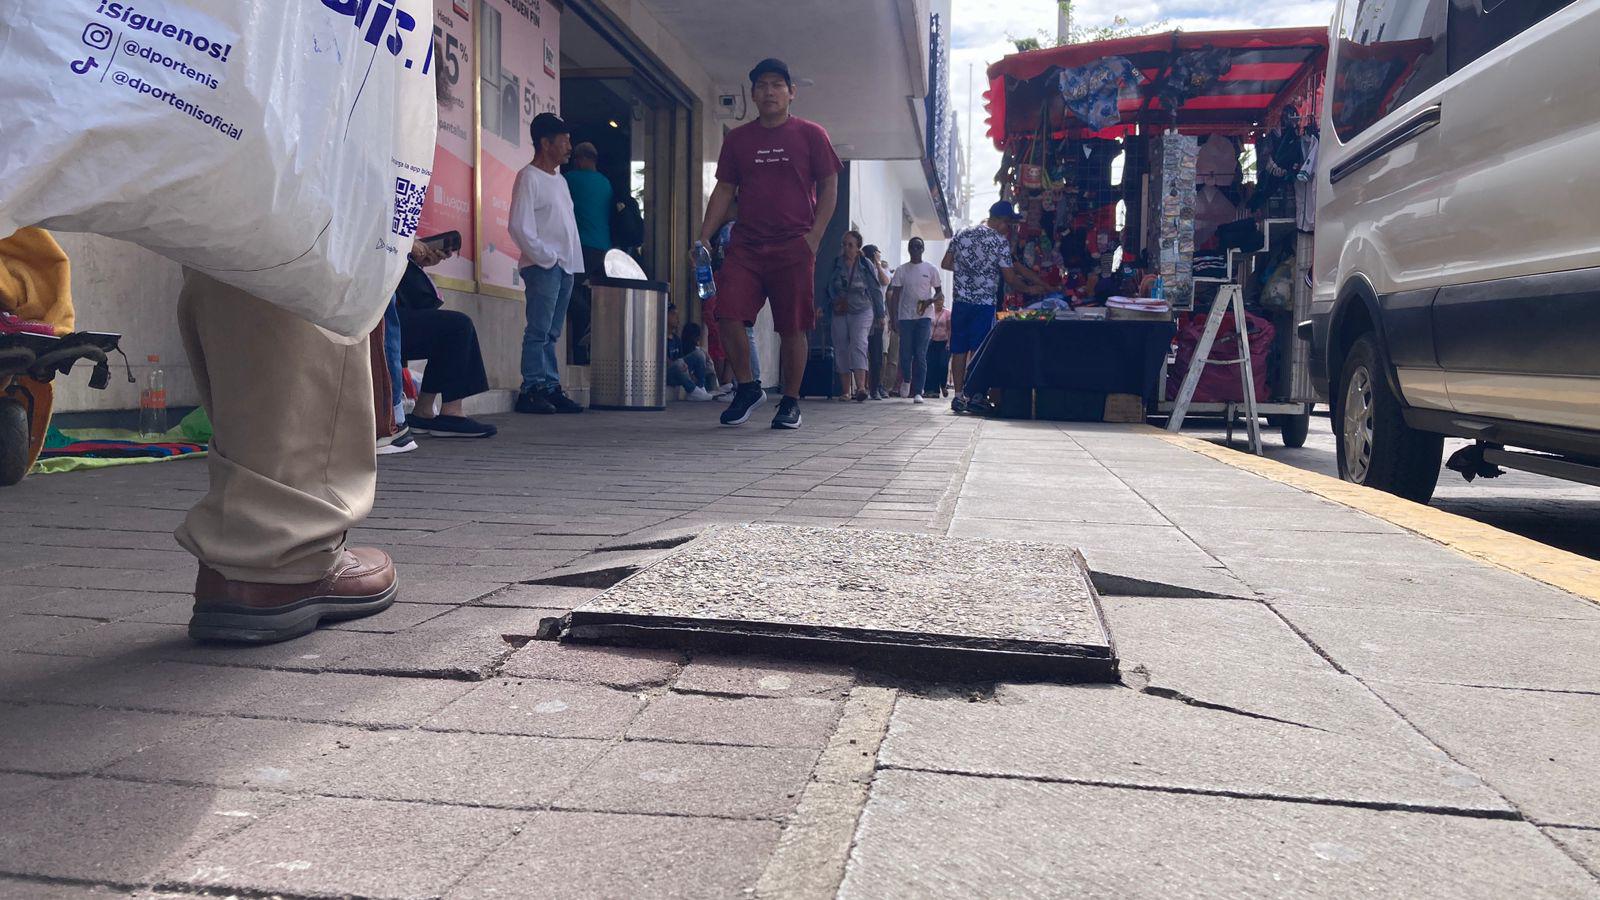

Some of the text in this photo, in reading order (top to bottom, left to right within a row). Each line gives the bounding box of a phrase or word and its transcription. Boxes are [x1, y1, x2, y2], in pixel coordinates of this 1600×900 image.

[437, 9, 453, 28] Hasta
[123, 40, 219, 90] @dportenis
[112, 71, 243, 141] @dportenisoficial
